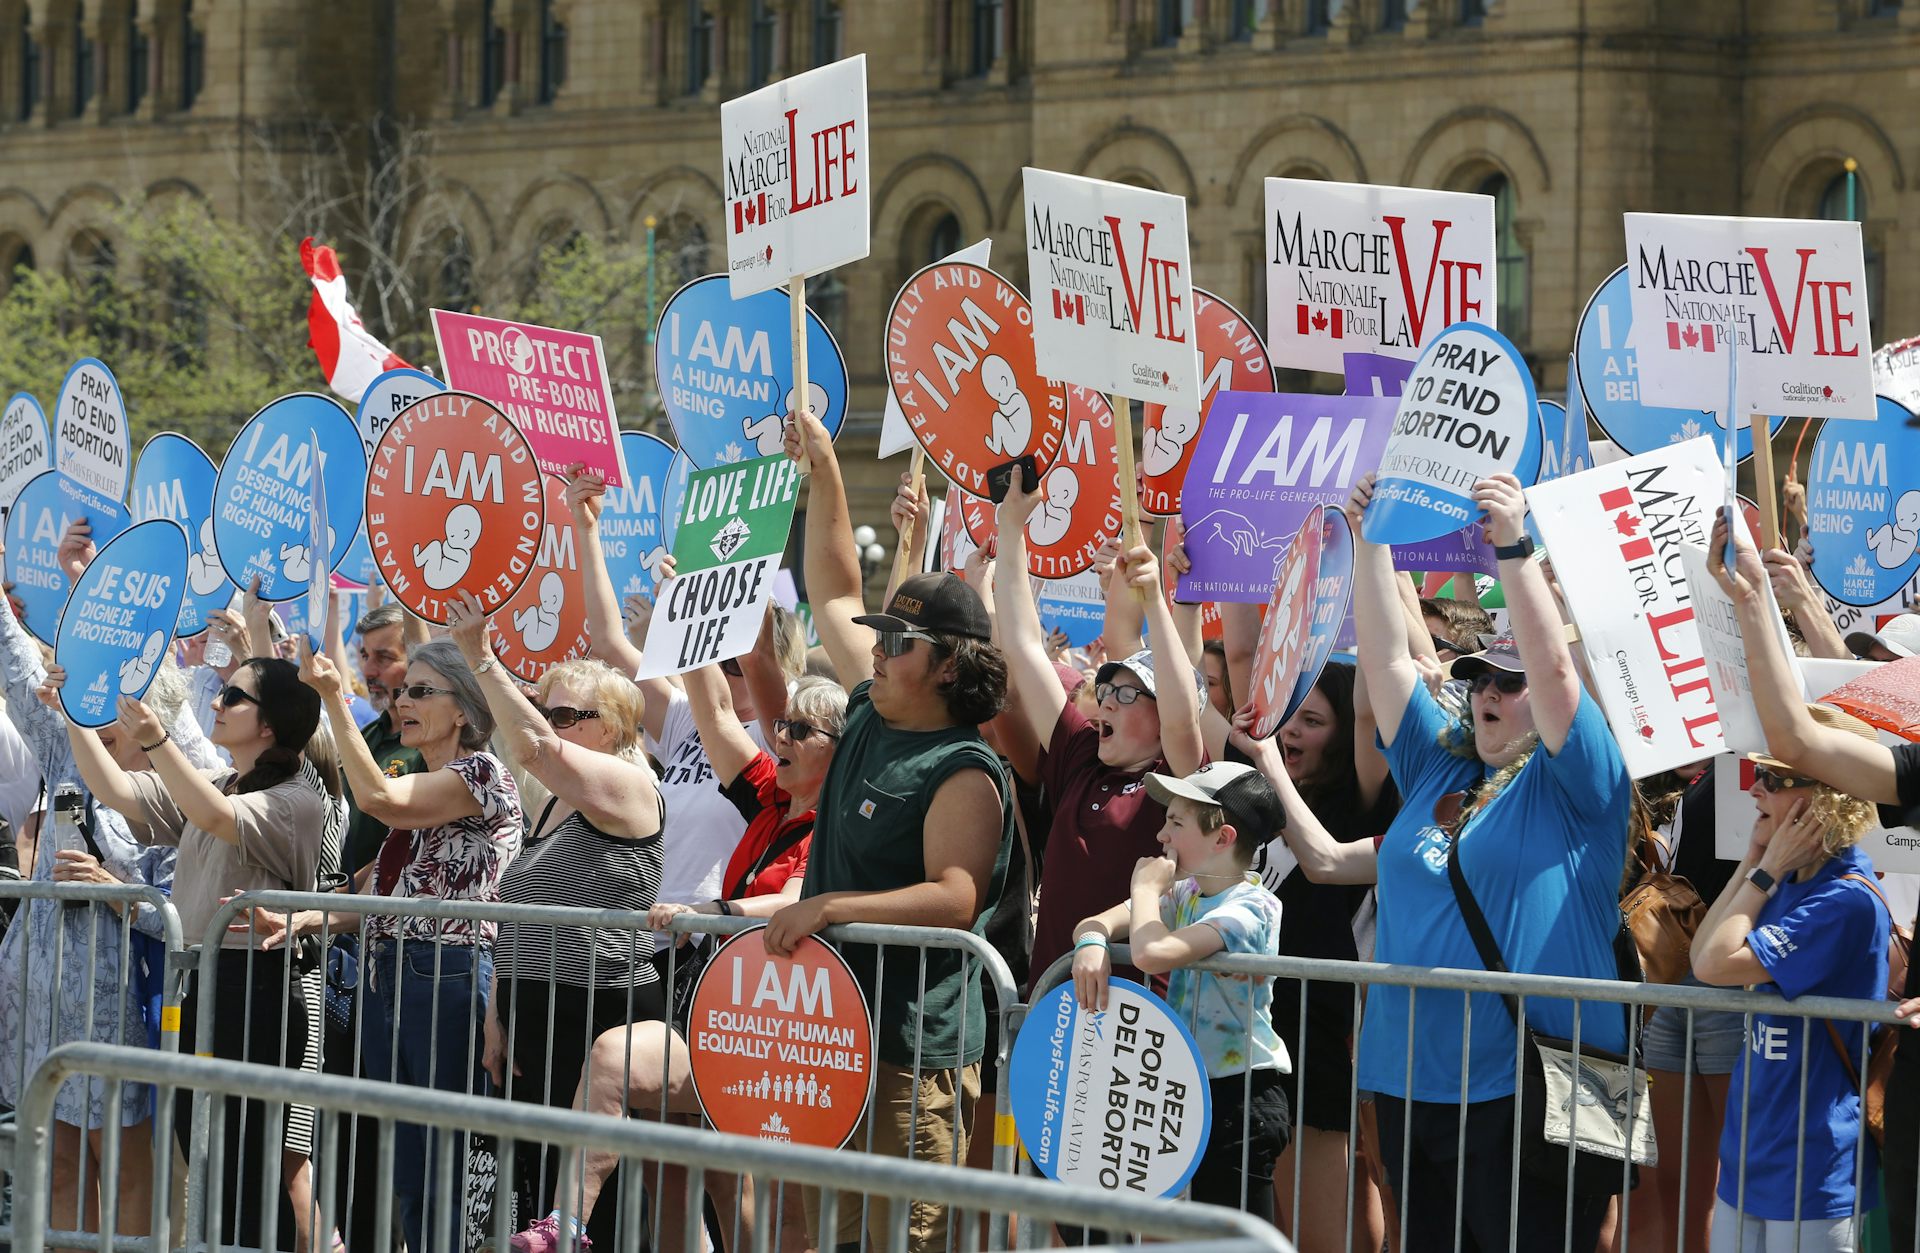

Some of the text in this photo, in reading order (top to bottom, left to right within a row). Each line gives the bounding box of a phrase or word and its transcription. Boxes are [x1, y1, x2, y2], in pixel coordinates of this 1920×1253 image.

[784, 108, 858, 215] LIFE
[731, 253, 756, 271] Campaign
[756, 249, 765, 263] Life
[1104, 215, 1186, 344] VIE
[1383, 216, 1482, 348] VIE
[1745, 247, 1859, 357] VIE
[671, 312, 773, 377] I AM
[1219, 319, 1265, 374] AND
[1598, 304, 1612, 350] I
[467, 326, 591, 382] PROTECT
[913, 296, 1001, 413] I AM
[1132, 363, 1162, 380] Coalition
[1431, 343, 1500, 377] PRAY
[1603, 356, 1622, 376] A
[81, 372, 111, 404] PRAY
[507, 372, 601, 414] PRE-BORN
[672, 362, 769, 402] A HUMAN
[890, 267, 985, 490] FEARFULLY AND ADE
[1410, 376, 1435, 402] TO
[1436, 379, 1500, 416] END
[1605, 381, 1640, 401] BEI
[1781, 382, 1822, 396] Coalition
[2, 403, 25, 437] PRAY
[71, 396, 116, 435] TO END
[672, 385, 725, 419] BEING
[1073, 385, 1113, 429] AND
[10, 424, 33, 455] END
[61, 420, 123, 468] ABORTION
[243, 421, 265, 464] I
[370, 415, 389, 434] PO
[483, 413, 527, 464] AND
[534, 407, 608, 445] RIGHTS!
[1392, 410, 1511, 461] ABORTION
[0, 440, 43, 483] ORTION
[371, 397, 473, 497] FEARFULLY
[1211, 413, 1366, 489] I AM
[1816, 440, 1888, 487] I AM
[235, 464, 313, 513] DESERVING
[404, 445, 415, 494] I
[421, 448, 505, 504] AM
[684, 458, 799, 525] LOVE LIFE
[1208, 487, 1345, 504] THE PRO-LIFE GENERATION
[58, 478, 117, 519] 40DaysForLife.com
[145, 478, 189, 520] AM
[230, 485, 252, 505] OF
[250, 493, 306, 533] HUMAN
[1814, 491, 1885, 513] A HUMAN
[18, 502, 27, 539] I
[221, 502, 274, 539] RIGHTS
[599, 518, 656, 537] HUMAN
[1812, 512, 1854, 535] BEING
[17, 545, 28, 563] A
[370, 512, 410, 594] MADE
[601, 540, 627, 558] ING
[1391, 551, 1477, 564] ATIONAL MARCH
[16, 565, 62, 591] BEING
[88, 564, 171, 609] JE SUIS
[241, 574, 272, 595] FO IFE
[667, 560, 767, 623] CHOOSE
[1189, 581, 1276, 595] THE NATIONAL MARC
[1843, 578, 1875, 590] MARCH
[1843, 588, 1875, 598] FOR LIFE
[79, 600, 136, 628] DIGNE DE
[894, 594, 923, 610] DUTCH
[71, 620, 144, 650] PROTECTION
[677, 615, 730, 669] LIFE
[1615, 649, 1640, 704] Campaign
[1633, 704, 1648, 726] Life
[732, 956, 834, 1018] I AM
[708, 1009, 855, 1048] EQUALLY HUMAN
[698, 1031, 863, 1073] EQUALLY VALUABLE
[1039, 990, 1073, 1165] 40DaysForLife.com
[1099, 1002, 1140, 1191] DEL ABORTO
[1126, 1028, 1165, 1192] POR EL FIN
[1157, 1079, 1187, 1155] REZA
[760, 1134, 791, 1145] MARCH
